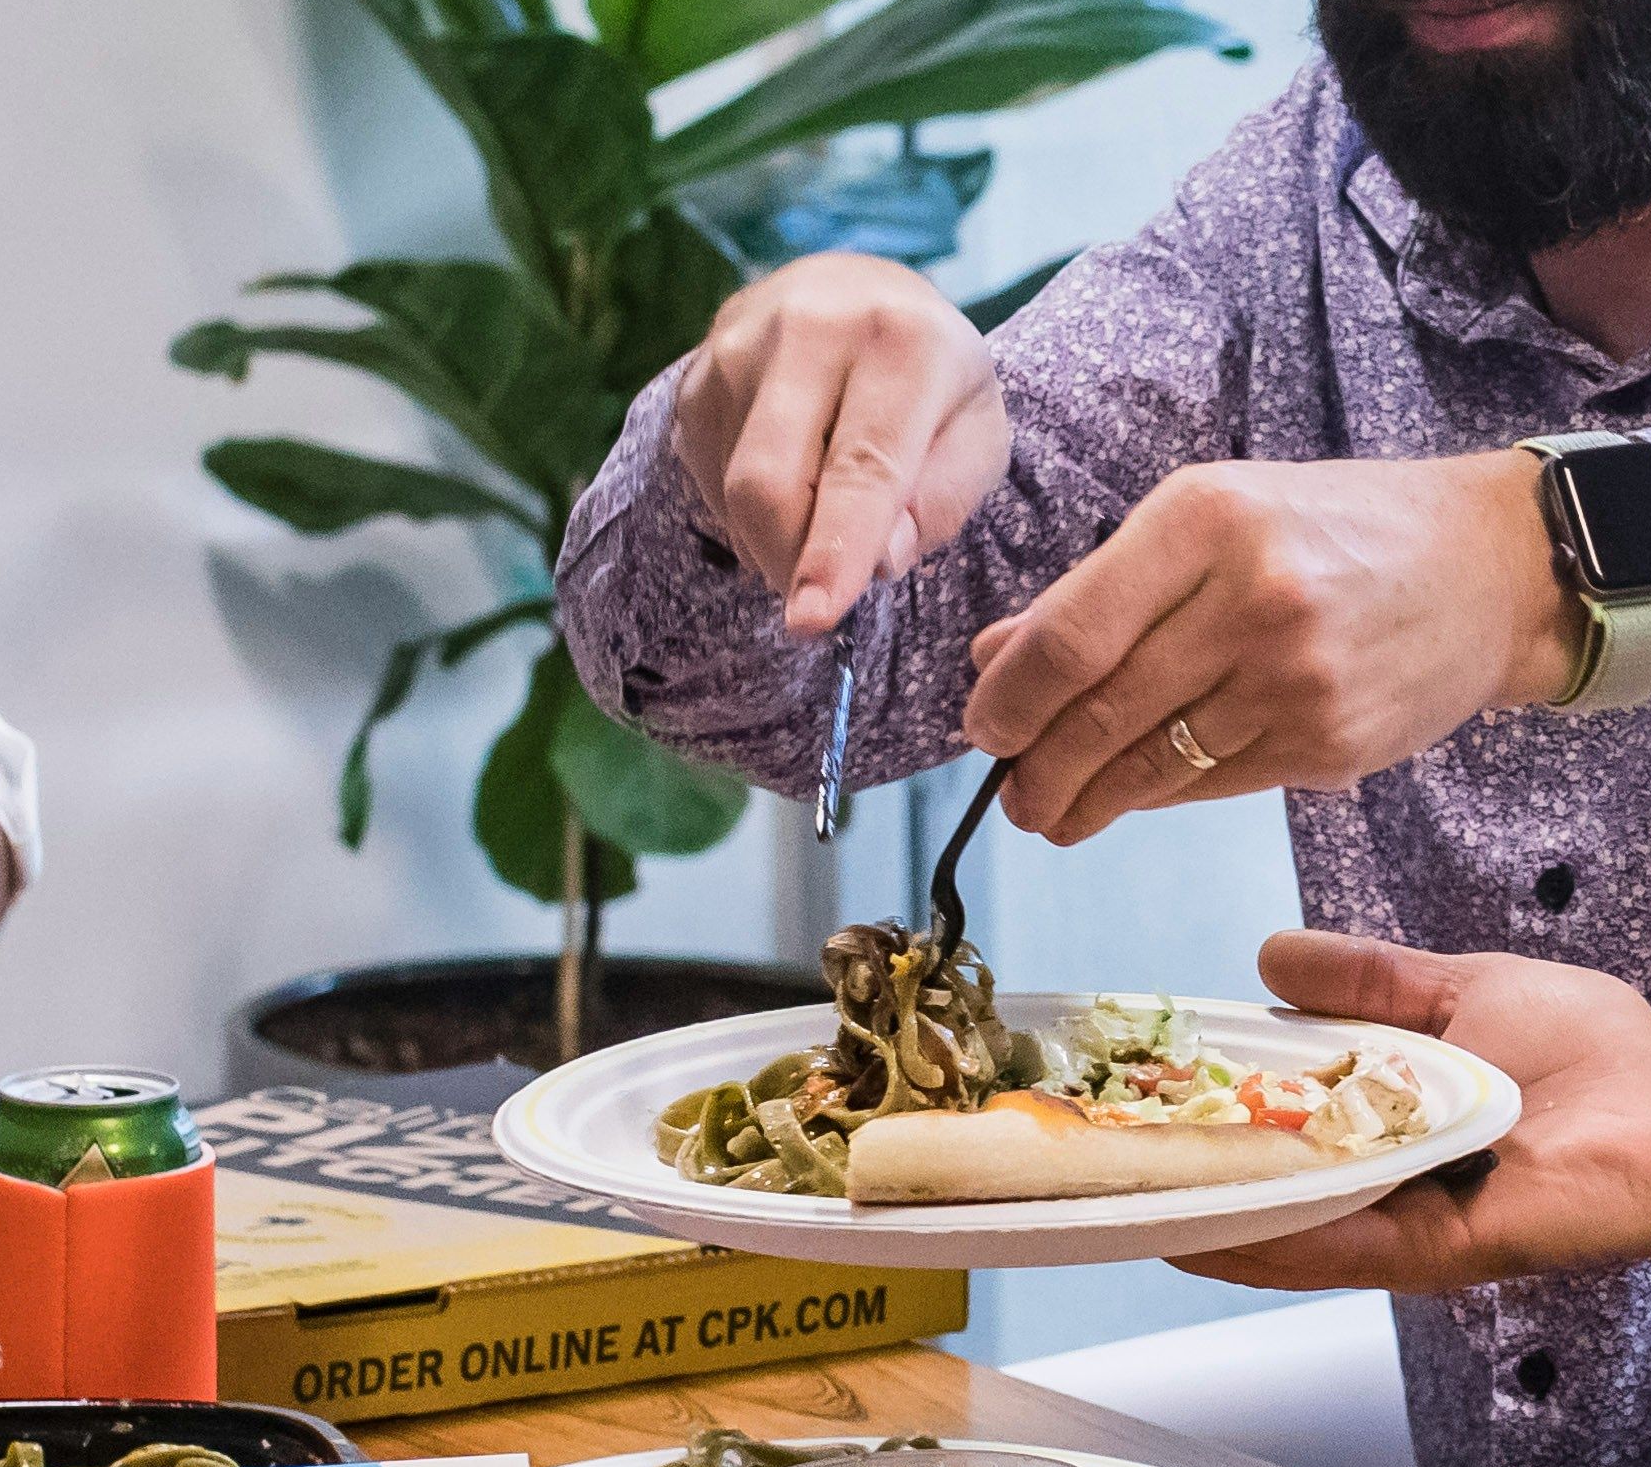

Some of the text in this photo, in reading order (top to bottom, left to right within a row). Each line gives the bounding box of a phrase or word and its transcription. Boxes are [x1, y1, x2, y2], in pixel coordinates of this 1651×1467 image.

[292, 1285, 888, 1405] ORDER ONLINE AT CPK.COM
